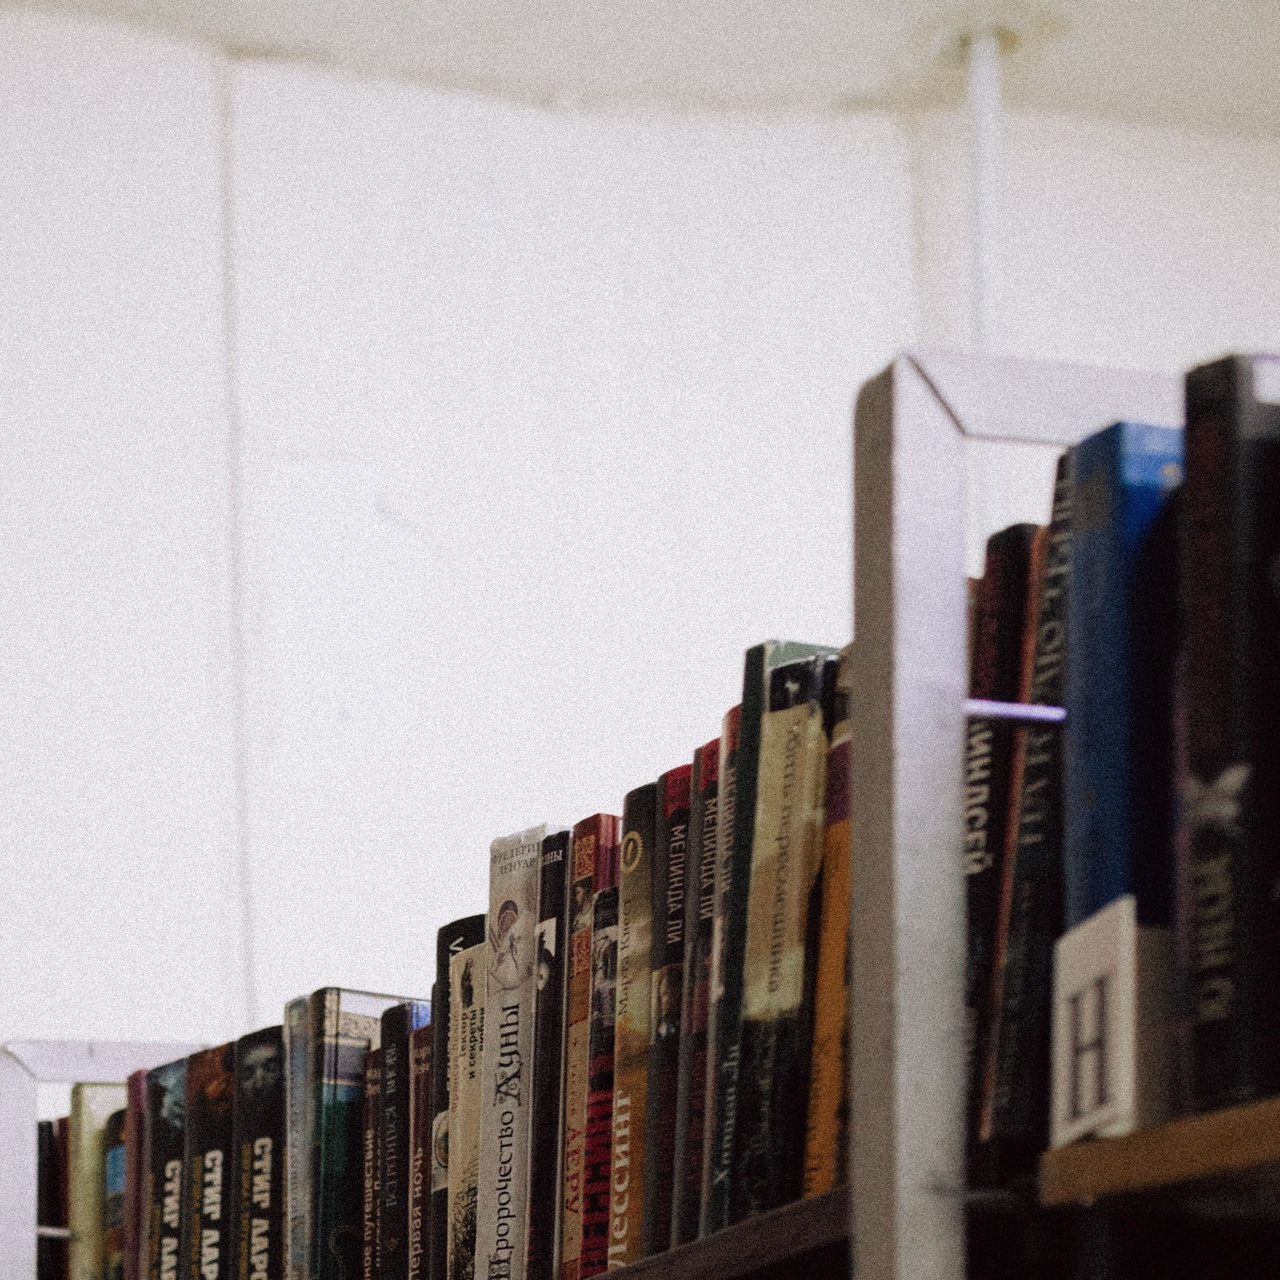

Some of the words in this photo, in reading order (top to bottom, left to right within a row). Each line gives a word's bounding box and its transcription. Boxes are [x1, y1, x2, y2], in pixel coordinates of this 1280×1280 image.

[667, 825, 687, 913] МЕЛИНДА
[701, 798, 719, 893] МЕЛИНДА
[666, 918, 683, 945] ЛИ
[700, 896, 717, 921] ЛИ
[470, 1009, 479, 1068] секреты
[493, 1003, 523, 1108] Луны
[163, 1160, 182, 1229] СТИГ
[203, 1150, 223, 1220] СТИГ
[252, 1137, 273, 1209] СТИГ
